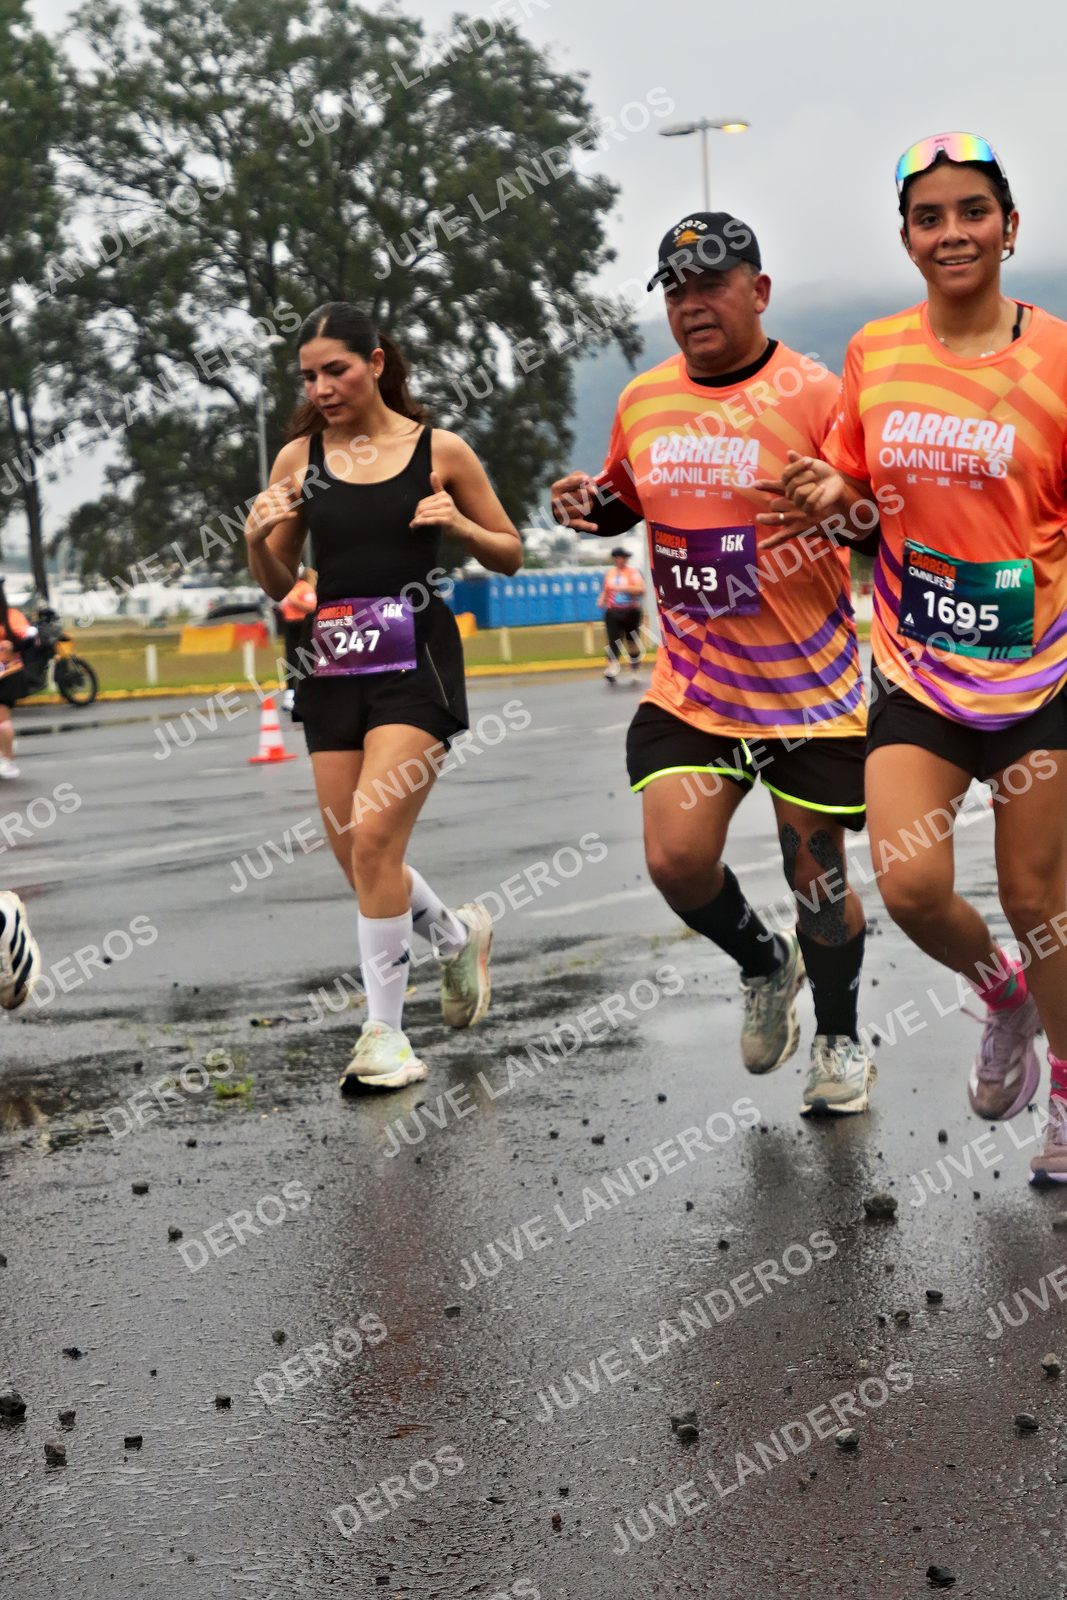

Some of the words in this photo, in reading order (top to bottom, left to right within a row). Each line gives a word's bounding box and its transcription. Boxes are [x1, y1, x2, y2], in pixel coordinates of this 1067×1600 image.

[882, 409, 1016, 454] CARRERA
[650, 435, 760, 465] CARRERA
[879, 446, 980, 474] OMNILIFE
[649, 466, 731, 486] OMNILIFE
[721, 534, 744, 552] 15K
[671, 565, 718, 591] 143
[995, 568, 1022, 589] 10K
[923, 591, 999, 632] 1695
[334, 629, 380, 654] 247
